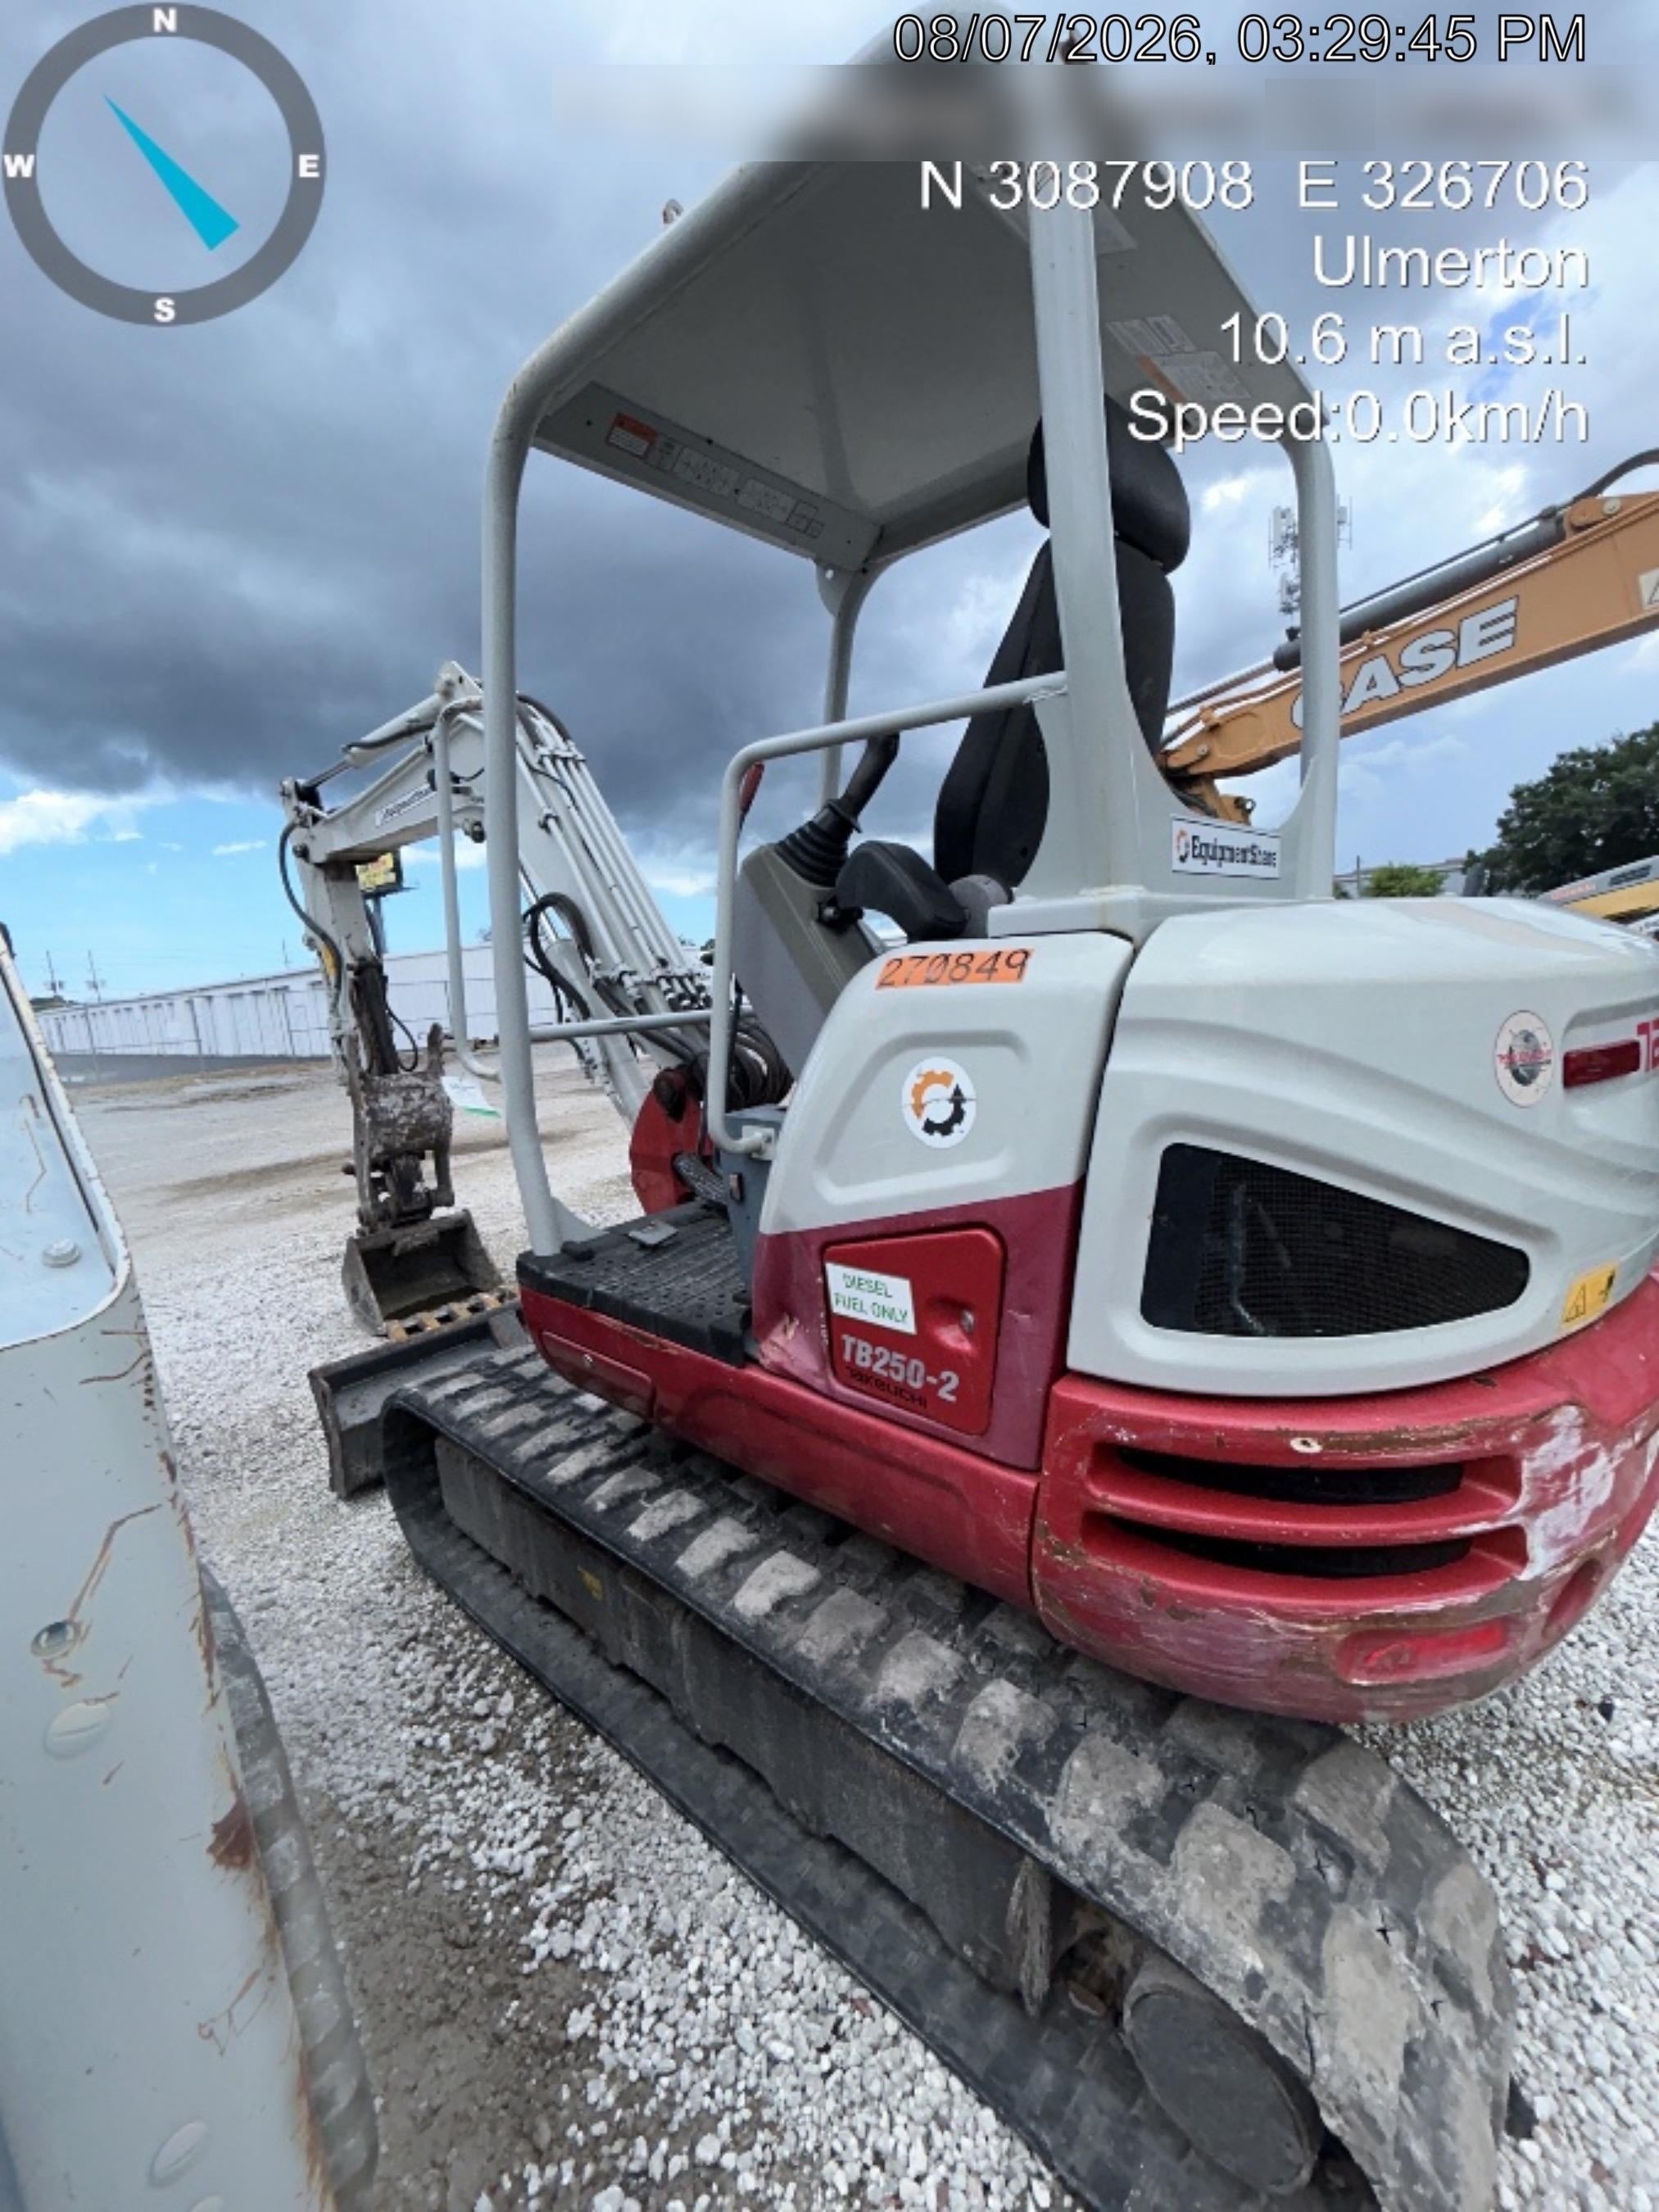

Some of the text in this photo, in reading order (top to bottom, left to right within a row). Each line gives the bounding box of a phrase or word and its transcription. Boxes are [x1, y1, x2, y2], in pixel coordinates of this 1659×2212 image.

[878, 949, 1031, 986] 270849
[843, 1273, 892, 1298] DIESEL
[834, 1293, 908, 1323] FUEL ONLY
[841, 1334, 959, 1403] TB250-2
